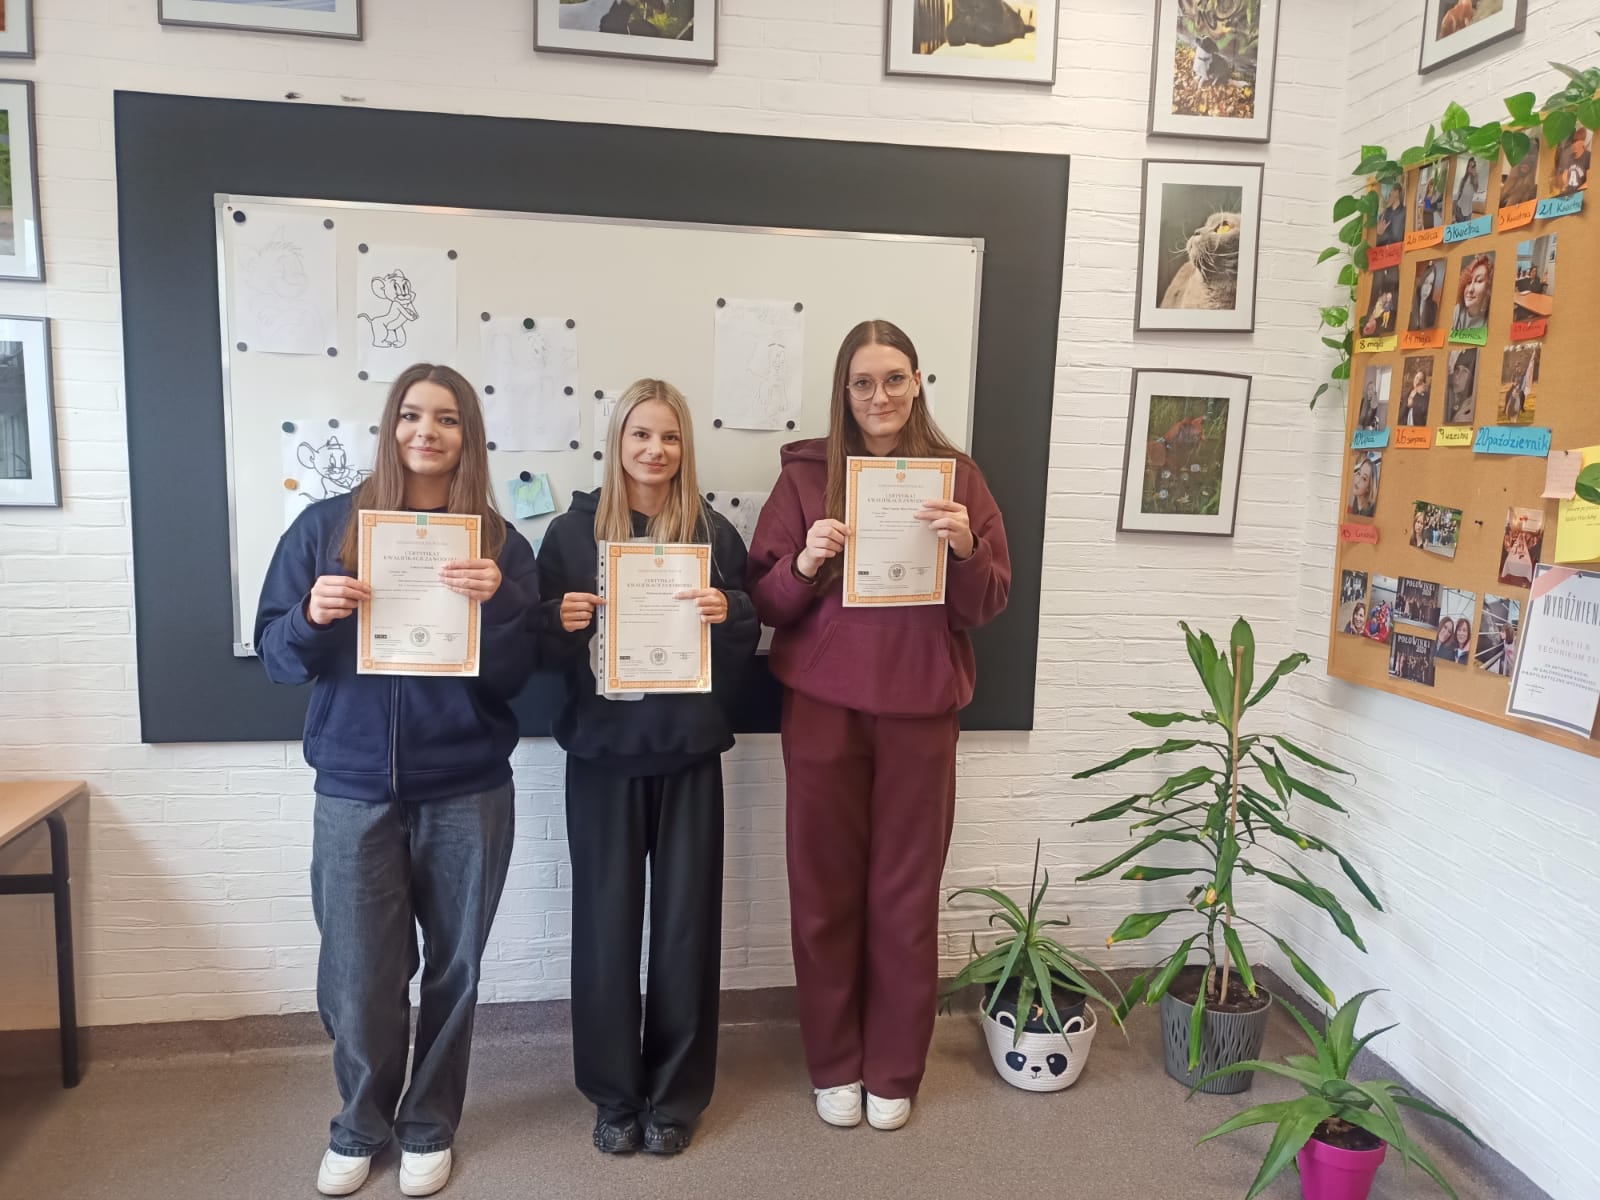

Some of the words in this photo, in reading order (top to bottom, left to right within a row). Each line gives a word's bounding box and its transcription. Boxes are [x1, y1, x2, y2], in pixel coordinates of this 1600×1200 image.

[1539, 203, 1552, 216] 21
[1359, 339, 1366, 350] 8
[1543, 591, 1600, 627] WYRÓŻNIEN
